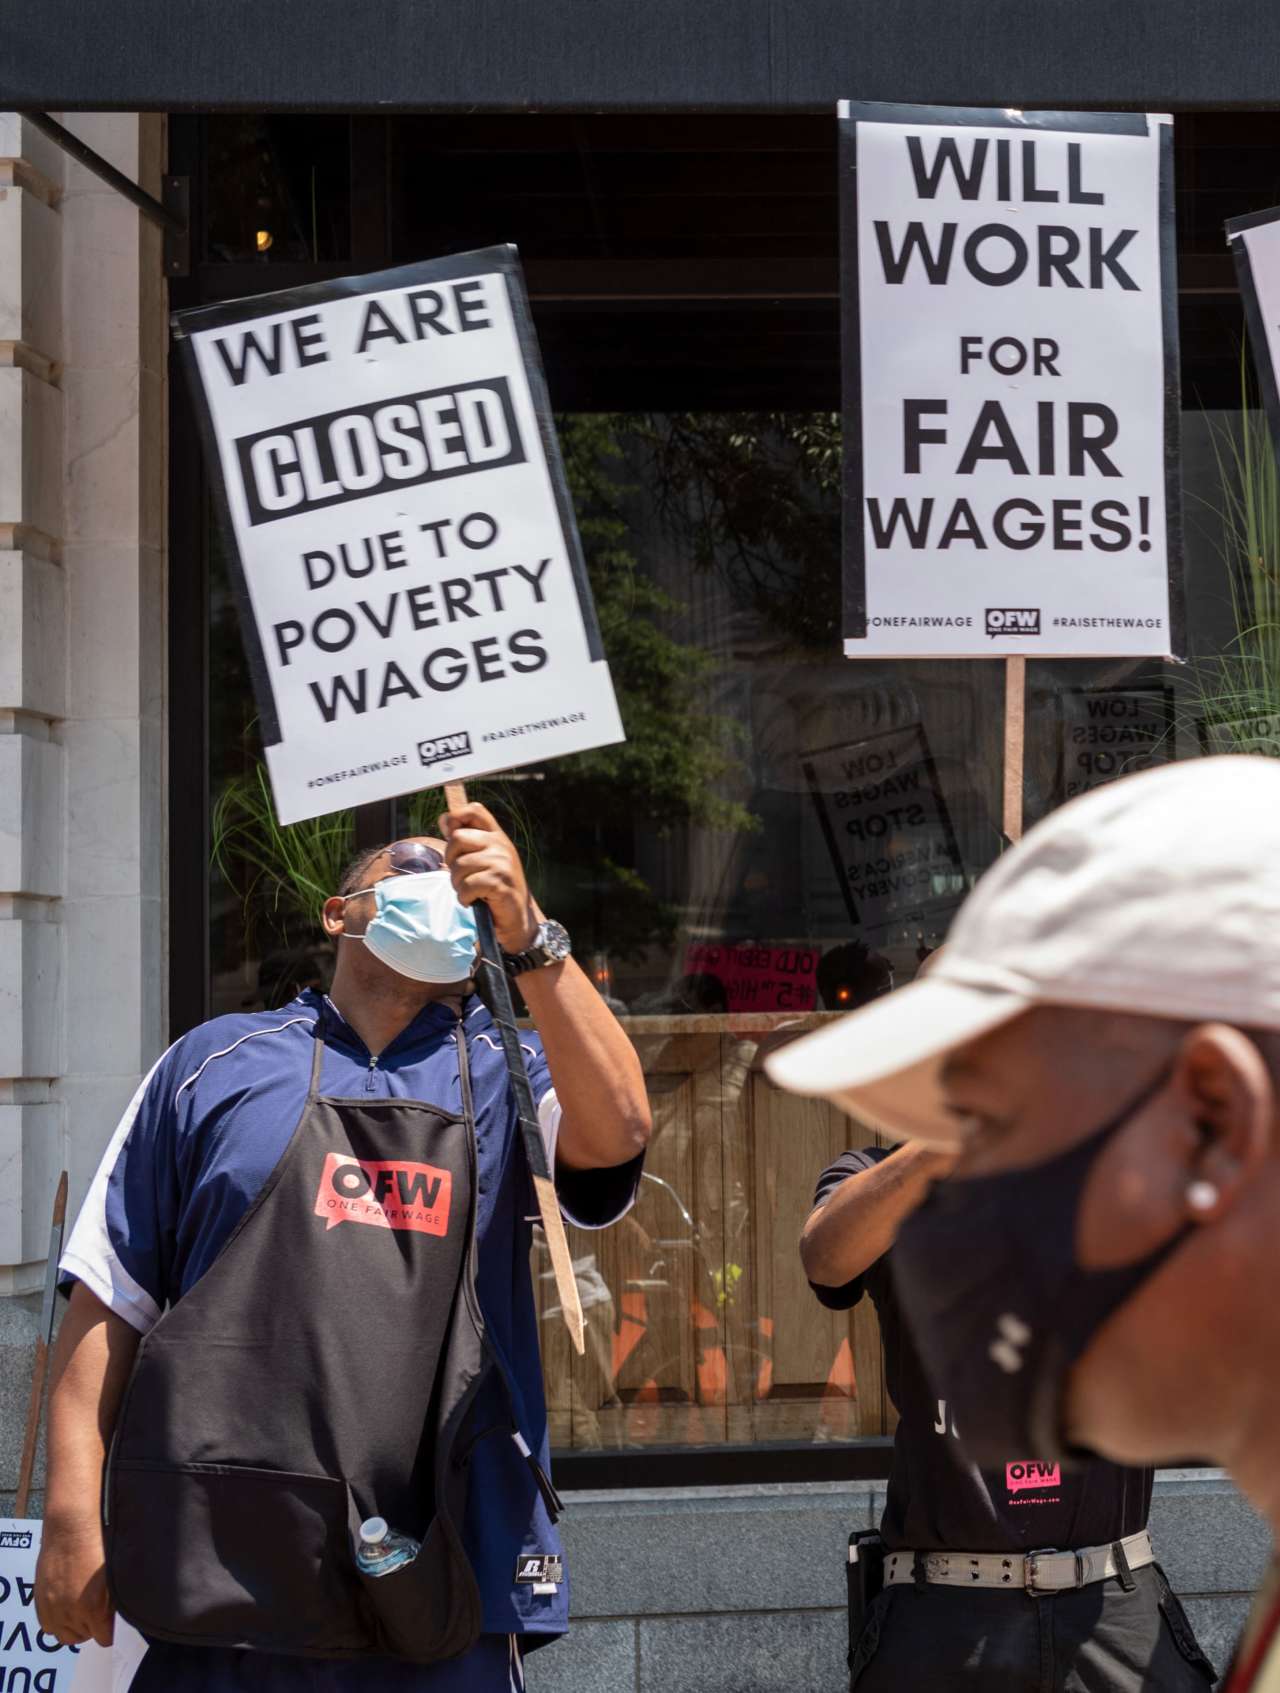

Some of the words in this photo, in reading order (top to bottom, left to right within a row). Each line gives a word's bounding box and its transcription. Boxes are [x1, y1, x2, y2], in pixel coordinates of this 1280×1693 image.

[905, 135, 1105, 205] WILL
[873, 220, 1142, 292] WORK
[211, 314, 331, 387] WE
[354, 281, 492, 354] ARE
[960, 336, 1061, 377] FOR
[249, 388, 512, 511] CLOSED
[903, 399, 1124, 477] FAIR
[866, 497, 1152, 553] WAGES!
[302, 530, 409, 590] DUE
[420, 512, 498, 558] TO
[272, 558, 553, 666] POVERTY
[988, 611, 1038, 627] OFW
[1053, 617, 1163, 629] #RAISETHEWAGE
[308, 629, 548, 723] WAGES
[420, 735, 467, 757] OFW
[482, 712, 587, 743] #RAISETHEWAGE
[308, 755, 408, 789] #ONEFAIRWAGE
[331, 1164, 442, 1209] OFW
[327, 1199, 359, 1212] ONE
[365, 1205, 399, 1219] FAIR
[402, 1209, 441, 1225] WAGE
[1010, 1463, 1055, 1480] OFW
